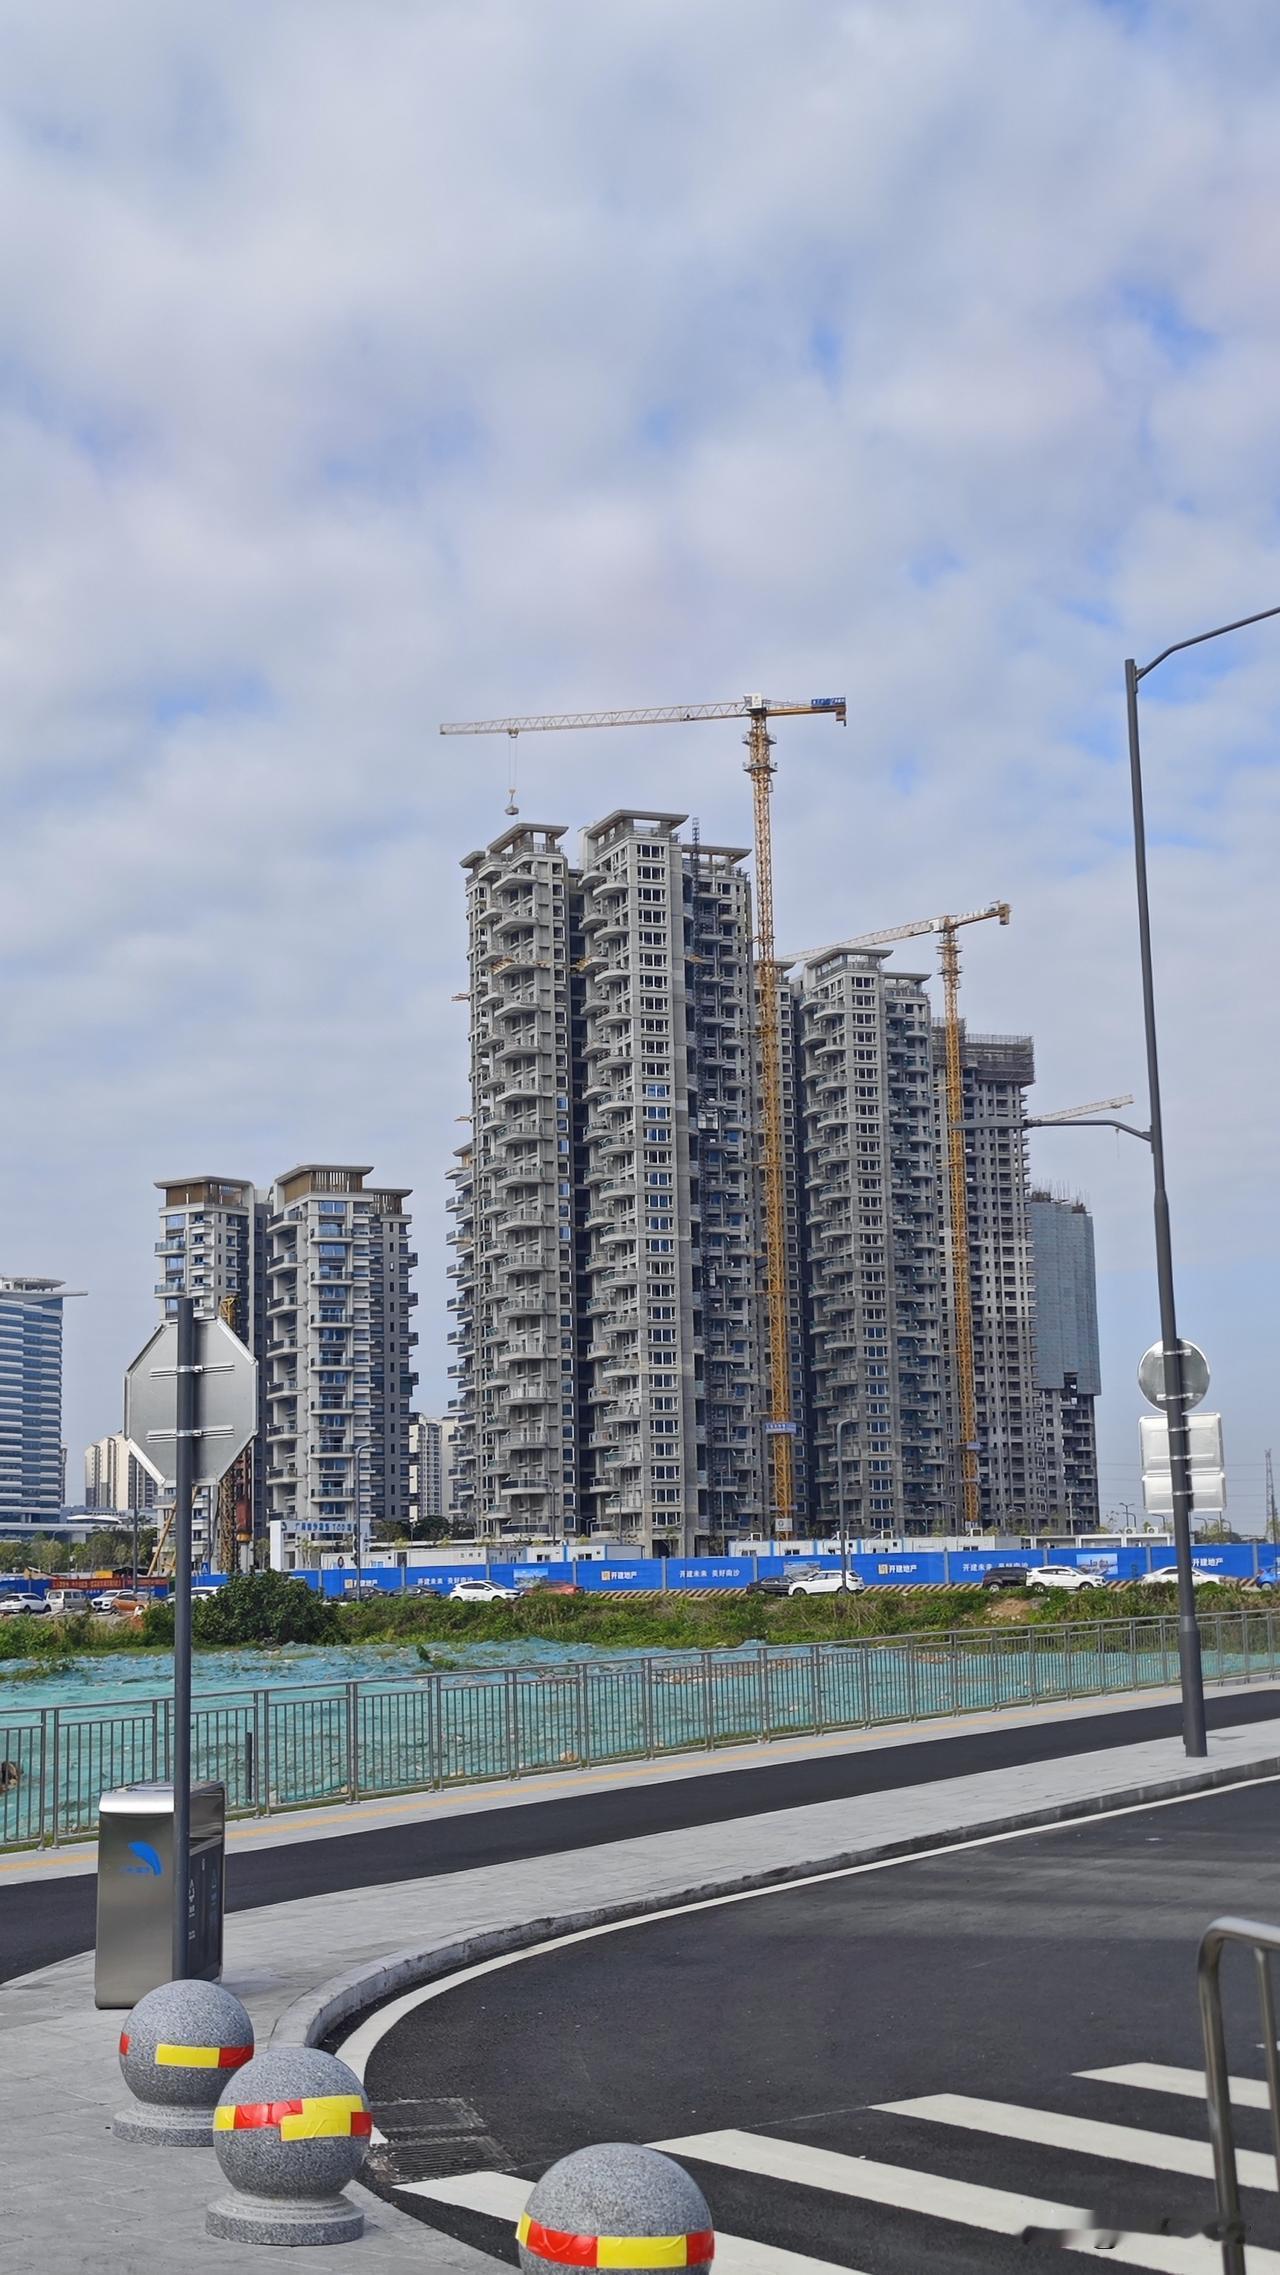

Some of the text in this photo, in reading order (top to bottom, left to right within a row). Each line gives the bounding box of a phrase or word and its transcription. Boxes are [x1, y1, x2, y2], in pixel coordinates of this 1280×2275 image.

[1192, 1557, 1224, 1566] 开建地产
[888, 1564, 918, 1574] 开建地产
[610, 1571, 638, 1580] 开建地产
[679, 1570, 707, 1578] 开建未来
